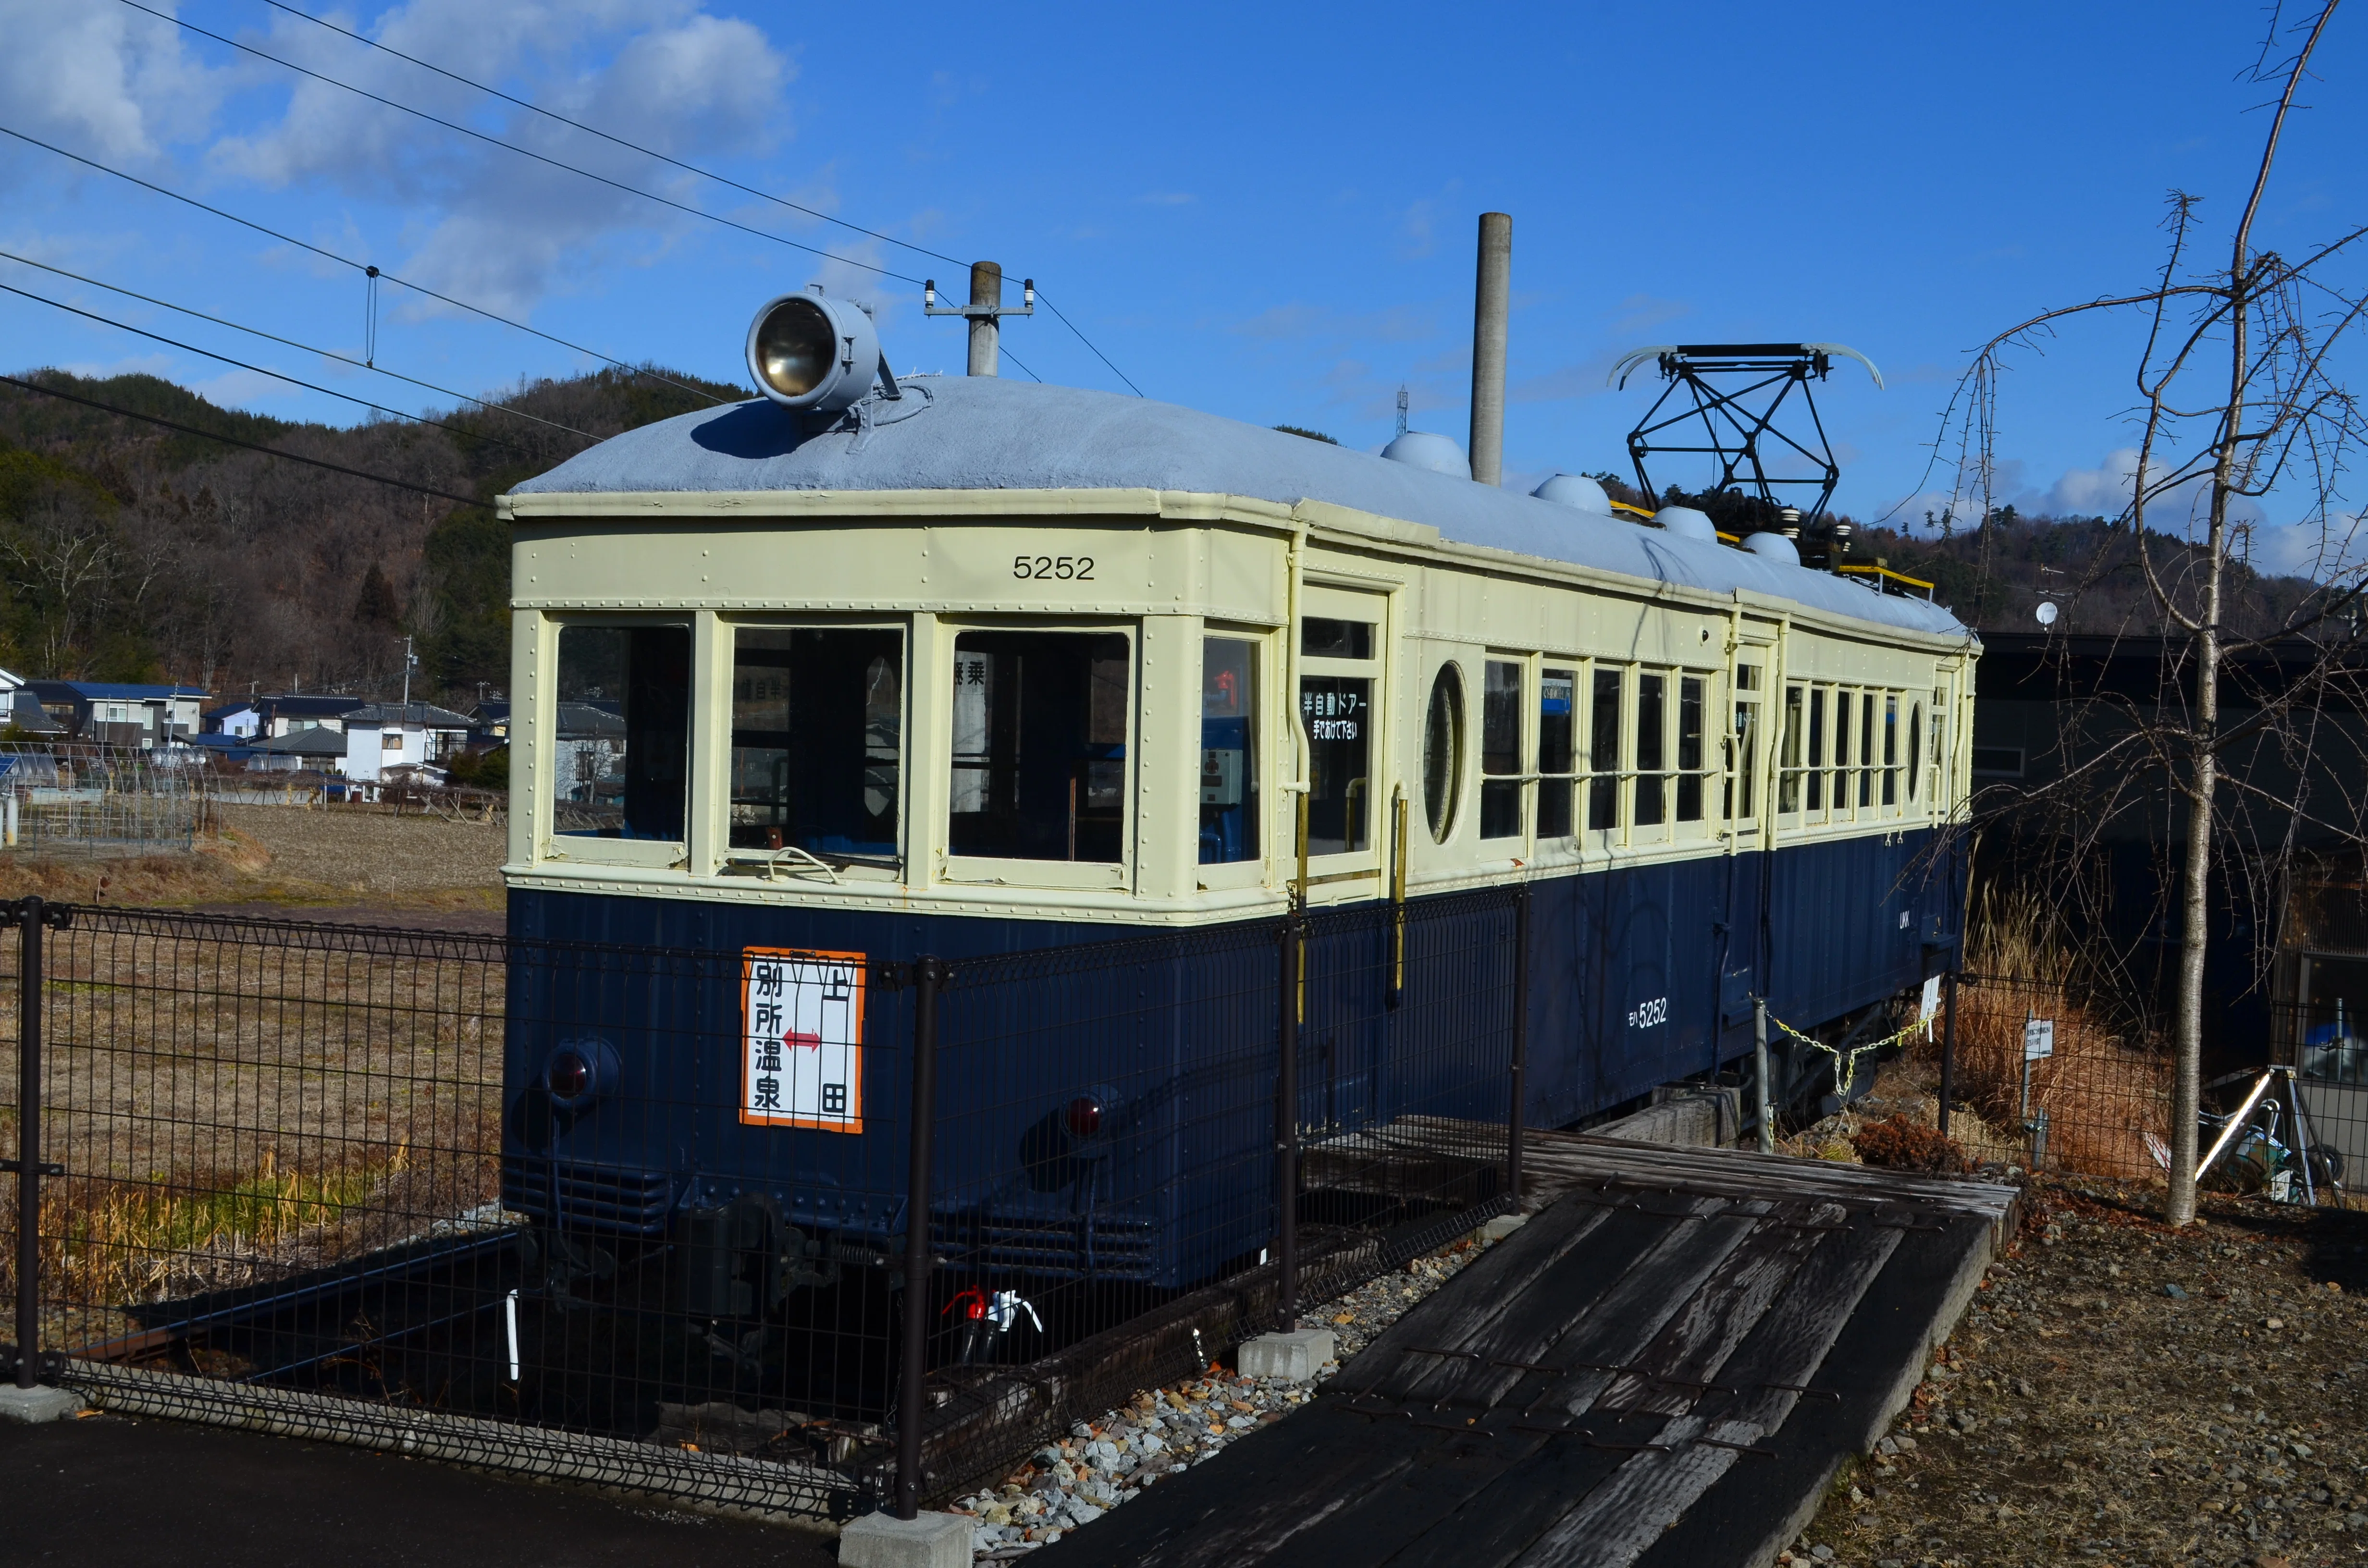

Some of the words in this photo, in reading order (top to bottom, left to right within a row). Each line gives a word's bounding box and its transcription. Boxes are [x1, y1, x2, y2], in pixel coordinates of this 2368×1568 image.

[1013, 556, 1095, 580] 5252
[1304, 692, 1367, 716] 半自動ドアー
[1313, 719, 1357, 740] 手であけて下さい
[1899, 910, 1909, 929] UKK
[754, 965, 783, 1108] 別所温泉
[822, 969, 848, 1113] 上田
